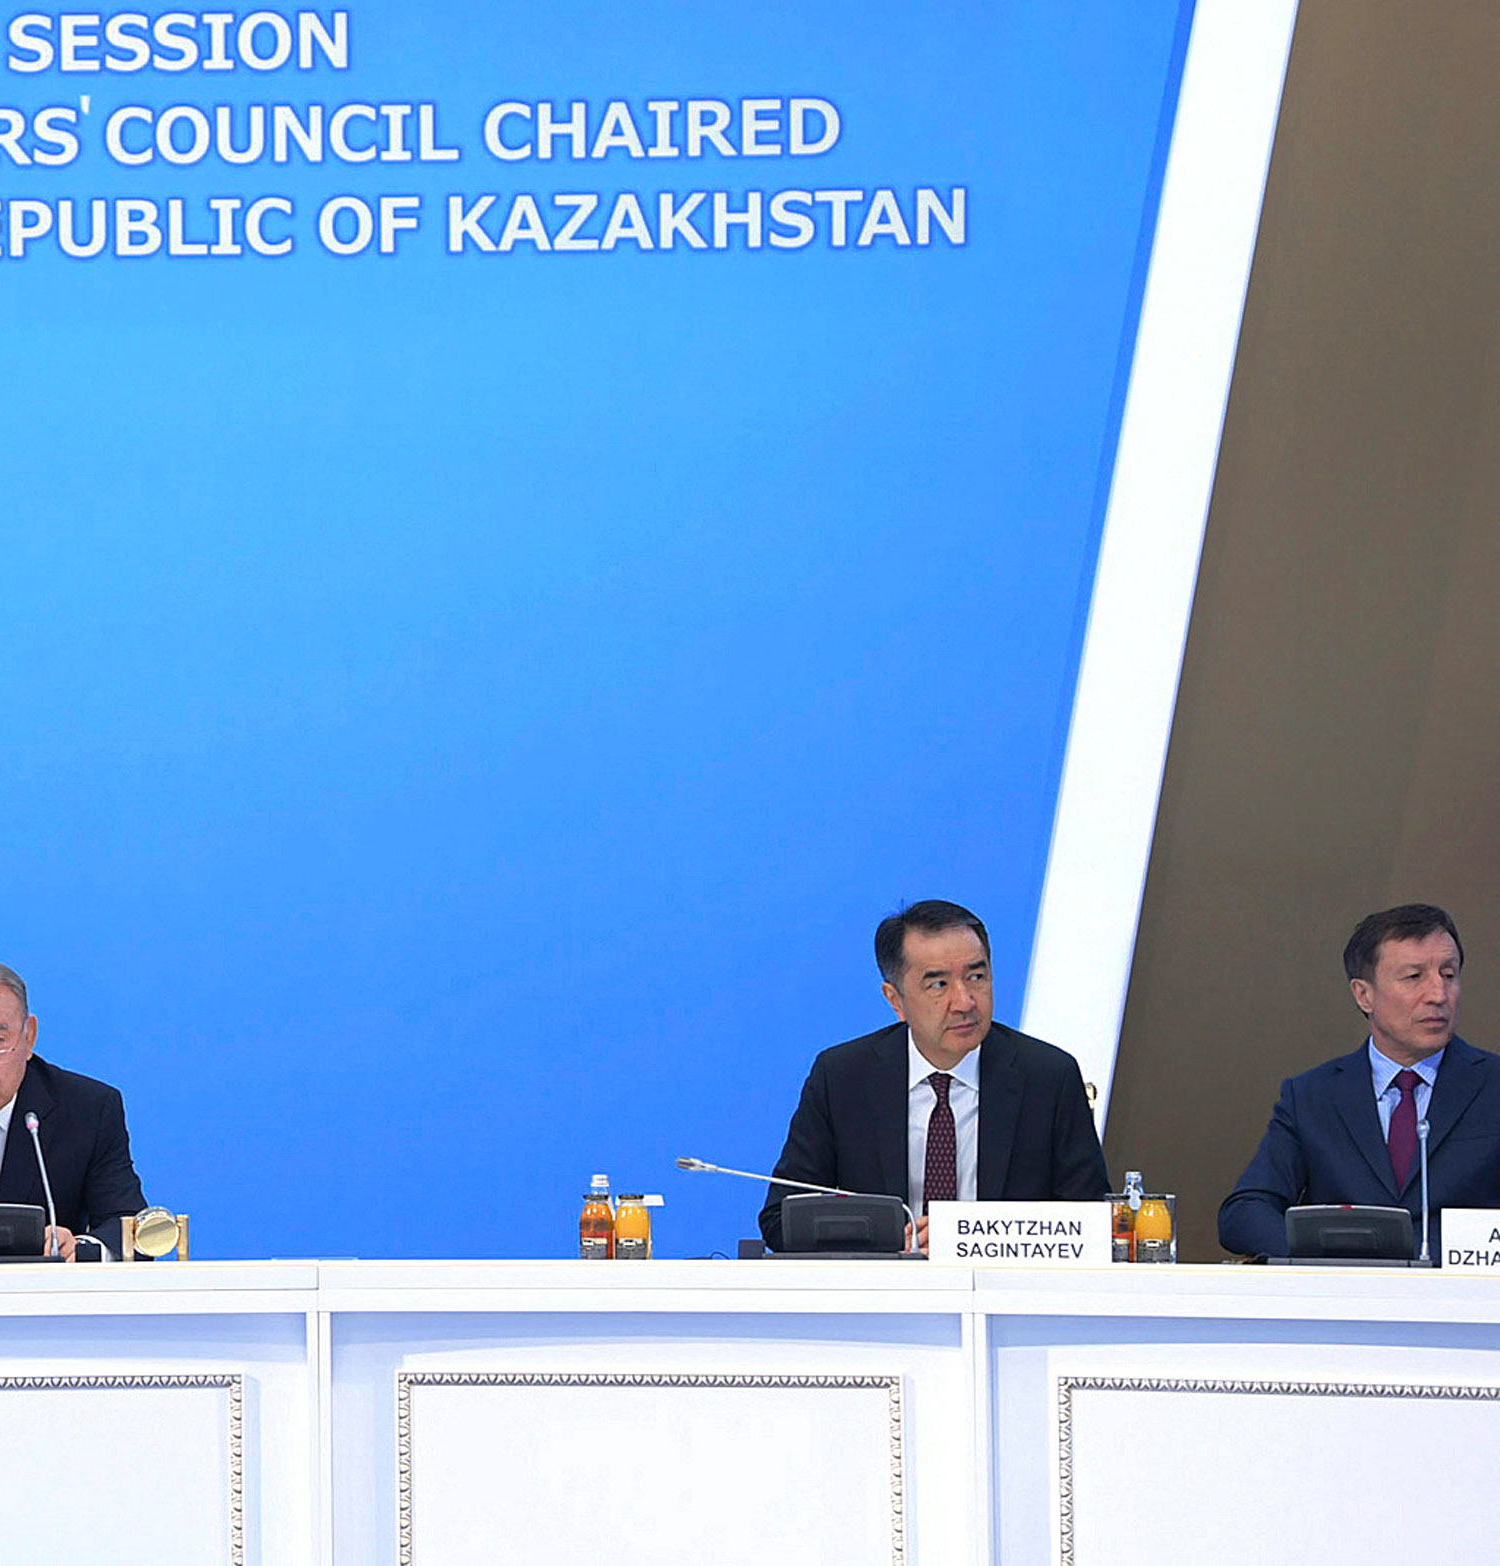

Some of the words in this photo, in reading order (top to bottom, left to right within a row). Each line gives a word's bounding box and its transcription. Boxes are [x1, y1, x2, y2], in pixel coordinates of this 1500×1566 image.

[8, 12, 348, 73] SESSION
[106, 104, 459, 165] COUNCIL
[484, 98, 840, 160] CHAIRED
[319, 196, 420, 255] OF
[449, 188, 965, 252] KAZAKHSTAN
[956, 1241, 1084, 1259] SAGINTAYEV
[957, 1219, 1082, 1236] BAKYTZHAN
